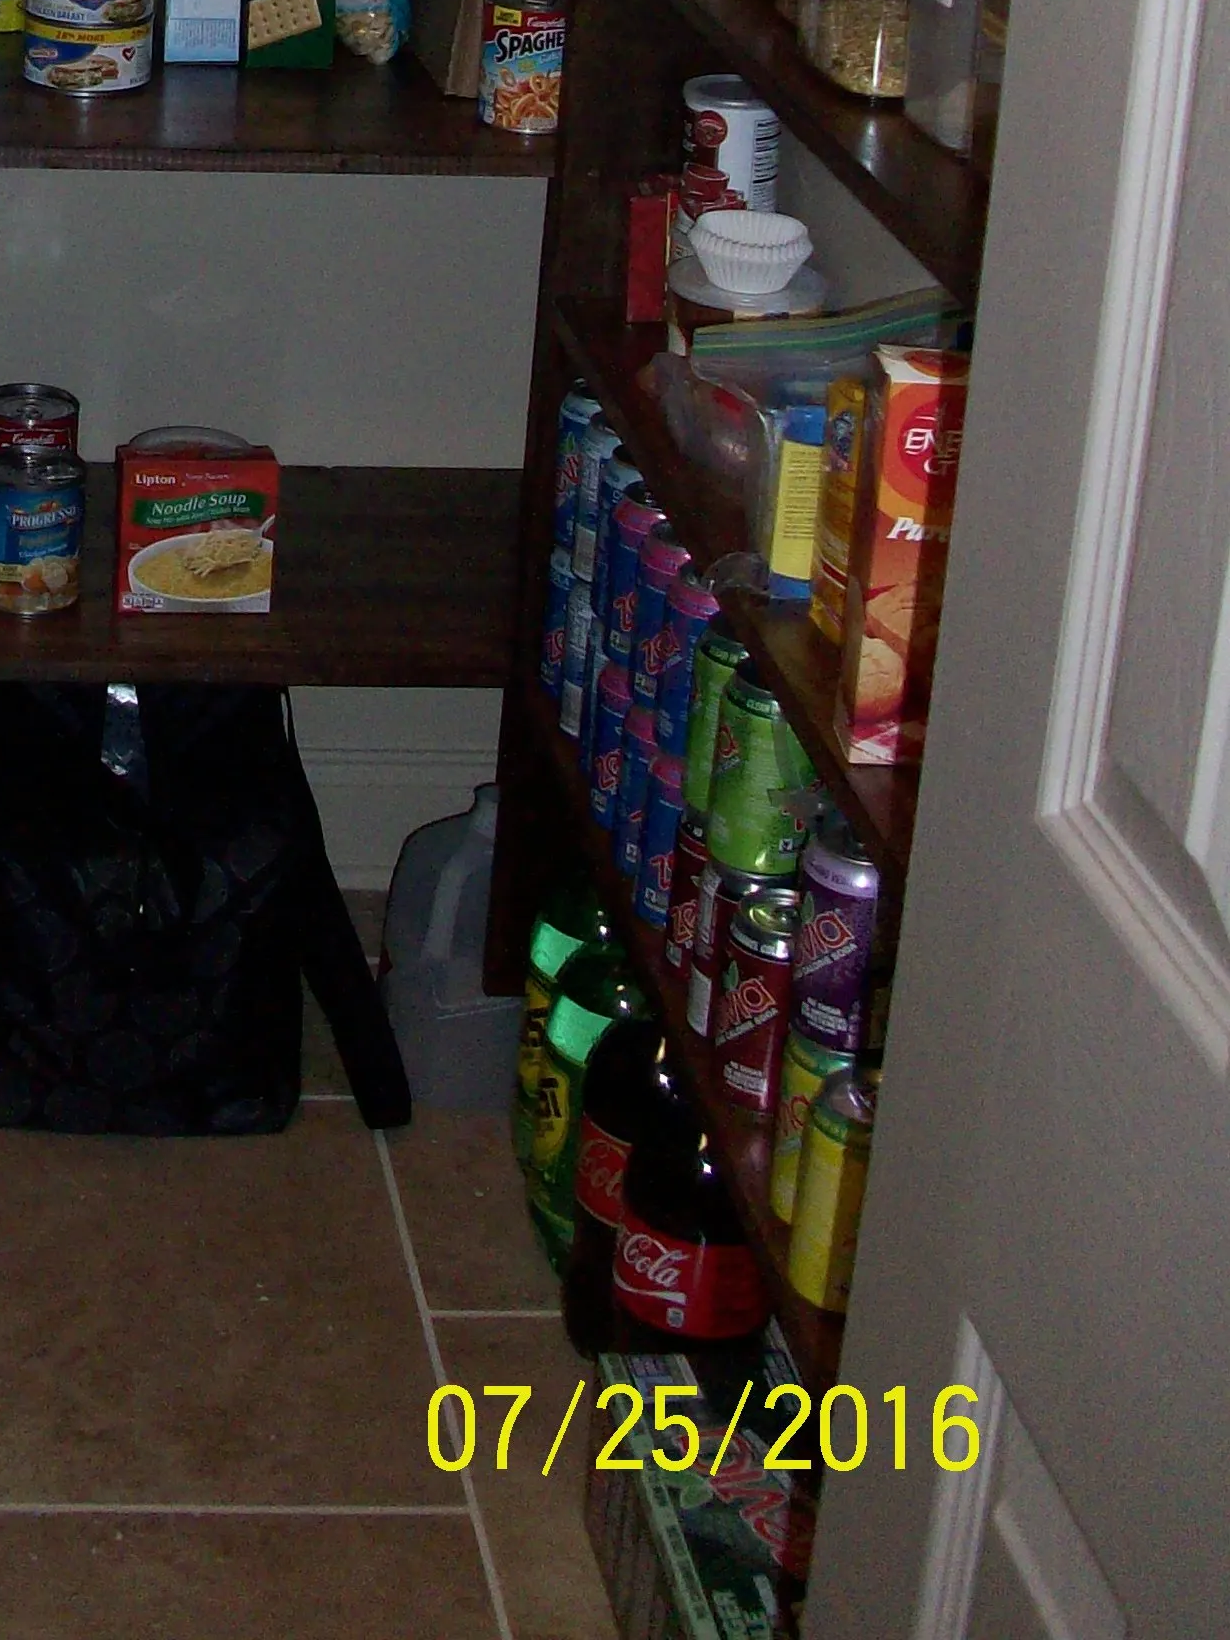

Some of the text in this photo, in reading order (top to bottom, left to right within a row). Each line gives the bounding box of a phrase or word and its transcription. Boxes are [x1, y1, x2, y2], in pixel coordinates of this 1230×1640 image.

[134, 473, 176, 487] Lipton
[151, 493, 248, 516] Noodle Soup
